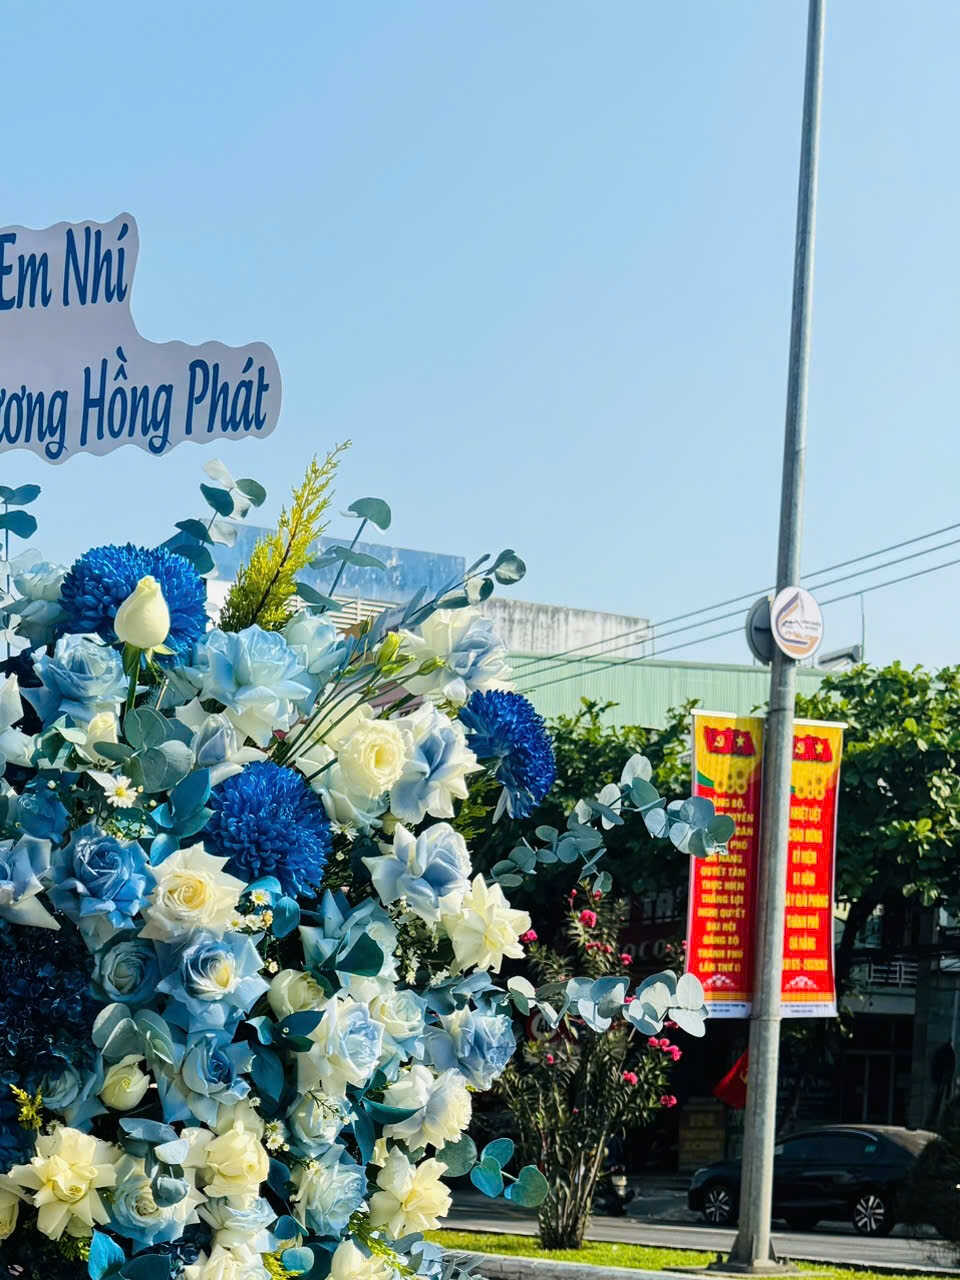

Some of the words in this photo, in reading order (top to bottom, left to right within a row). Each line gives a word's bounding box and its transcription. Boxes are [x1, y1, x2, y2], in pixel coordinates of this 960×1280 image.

[62, 222, 129, 307] Nhí
[79, 345, 174, 455] Hồng
[184, 356, 270, 436] Phát
